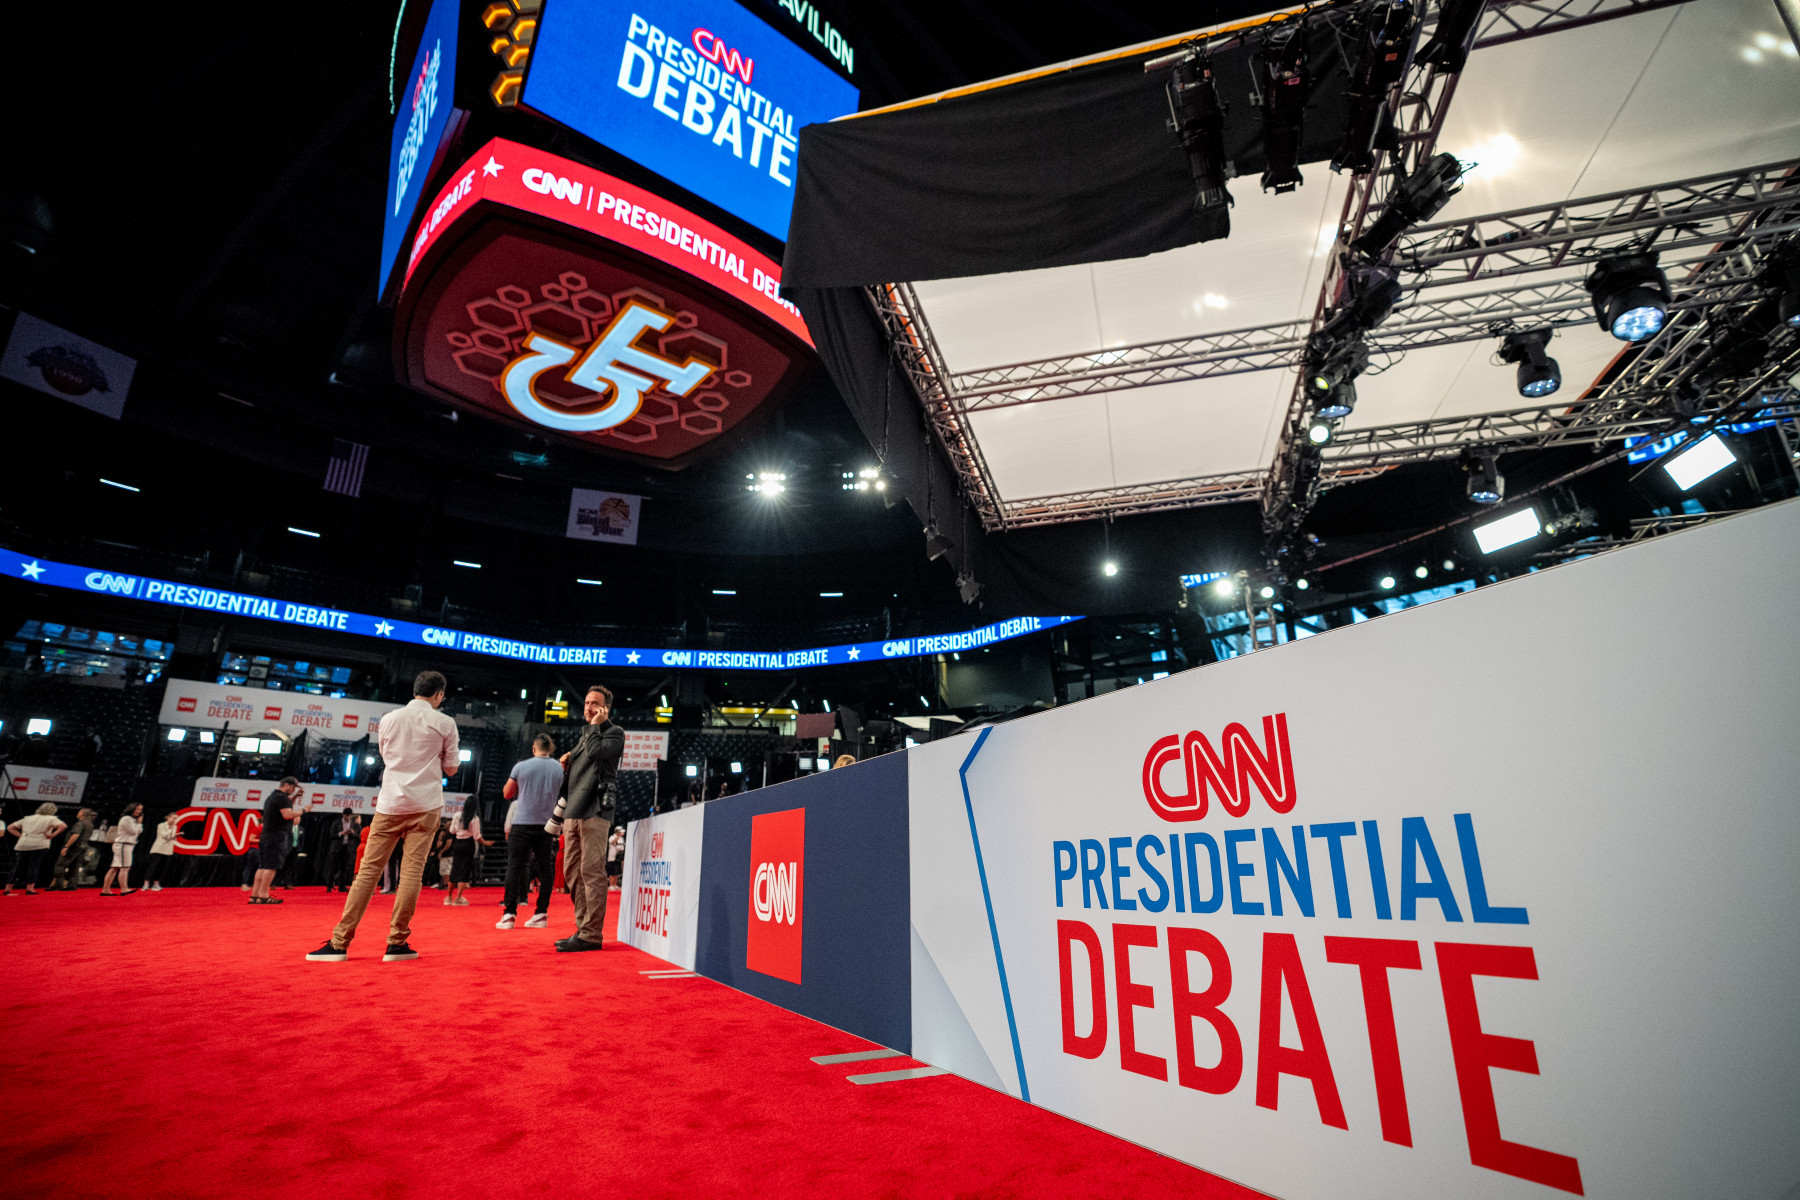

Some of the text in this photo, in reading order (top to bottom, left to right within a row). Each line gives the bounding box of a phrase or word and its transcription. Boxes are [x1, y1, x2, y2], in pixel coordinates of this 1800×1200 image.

[627, 13, 797, 143] PRESIDENTIAL
[691, 27, 754, 85] CNN
[617, 39, 796, 187] DEBATE
[429, 169, 475, 233] DEBATE
[522, 168, 583, 204] CNN
[597, 191, 749, 284] PRESIDENTIAL
[85, 572, 349, 631] CNN PRESIDENTIAL DEBATE
[422, 627, 607, 664] CNN PRESIDENTIAL DEBATE
[662, 649, 829, 668] CNN PRESIDENTIAL DEBATE
[882, 616, 1041, 657] CNN PRESIDENTIAL DEBATE
[207, 706, 252, 720] DEBATE
[291, 714, 333, 728] DEBATE
[38, 784, 76, 797] DEBATE
[1142, 712, 1297, 822] CNN
[200, 792, 237, 802] DEBATE
[332, 798, 363, 808] DEBATE
[651, 832, 664, 858] CNN
[1053, 812, 1530, 925] PRESIDENTIAL
[640, 861, 671, 885] PRESIDENTIAL
[753, 862, 797, 925] CNN
[635, 887, 670, 937] DEBATE
[1056, 918, 1585, 1197] DEBATE
